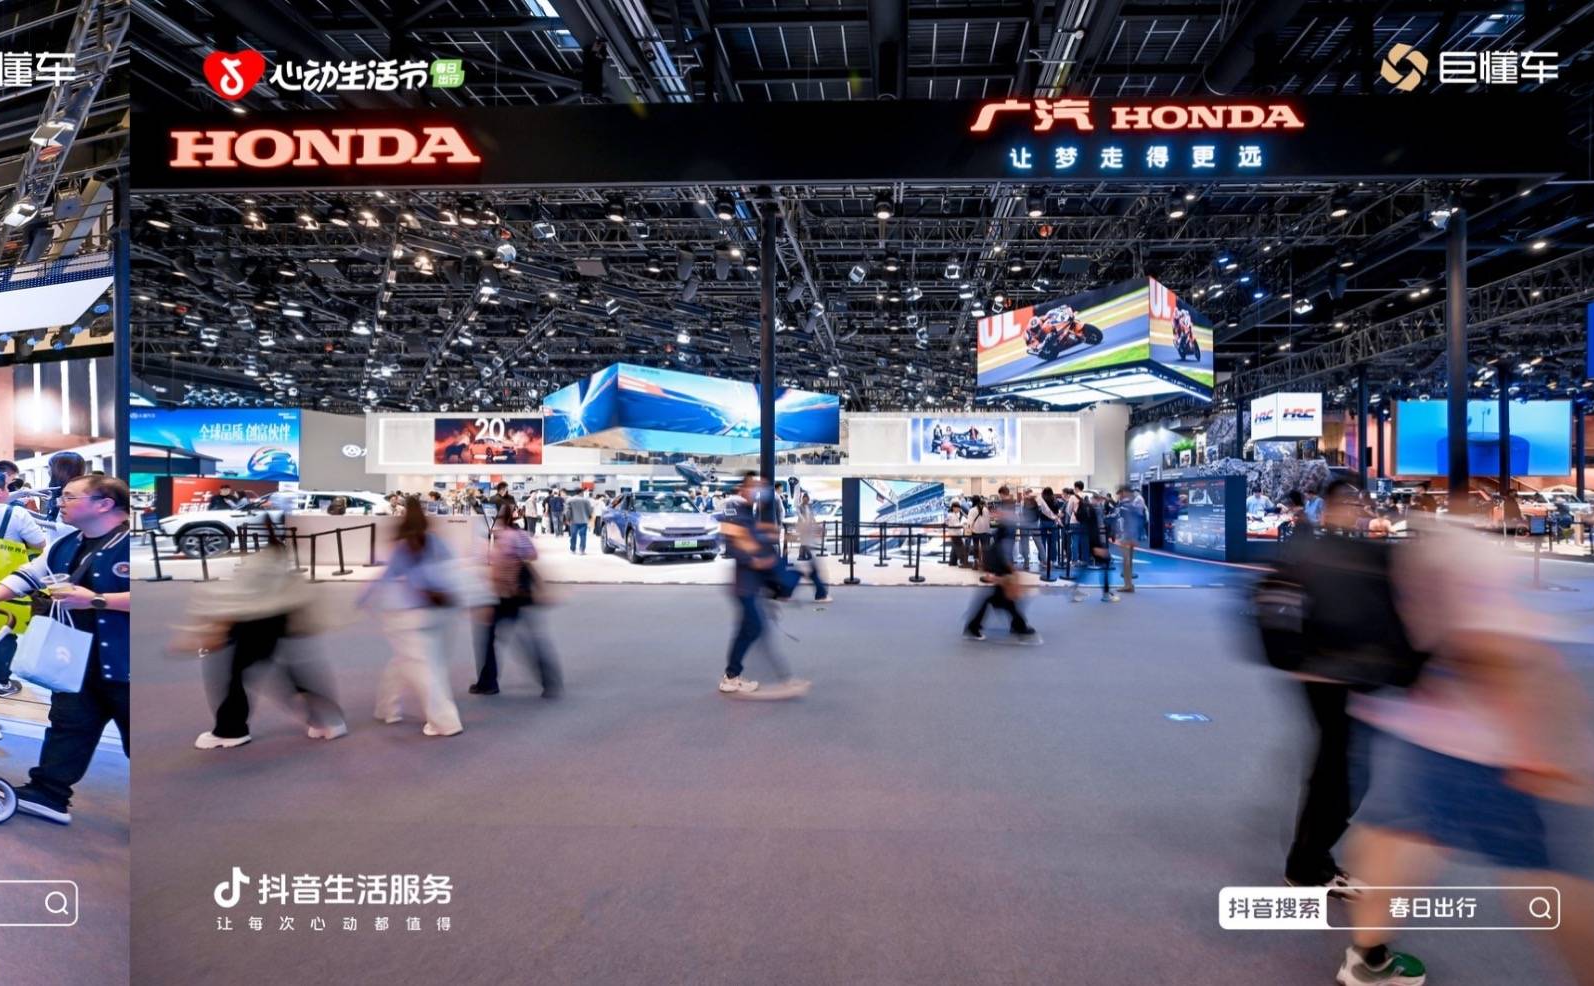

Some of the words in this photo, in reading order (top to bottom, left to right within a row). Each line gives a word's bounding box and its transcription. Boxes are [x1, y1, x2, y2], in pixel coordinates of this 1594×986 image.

[970, 99, 1094, 131] 广汽
[1111, 105, 1305, 130] HONDA
[169, 127, 481, 168] HONDA
[1009, 146, 1262, 168] 让梦走得更远
